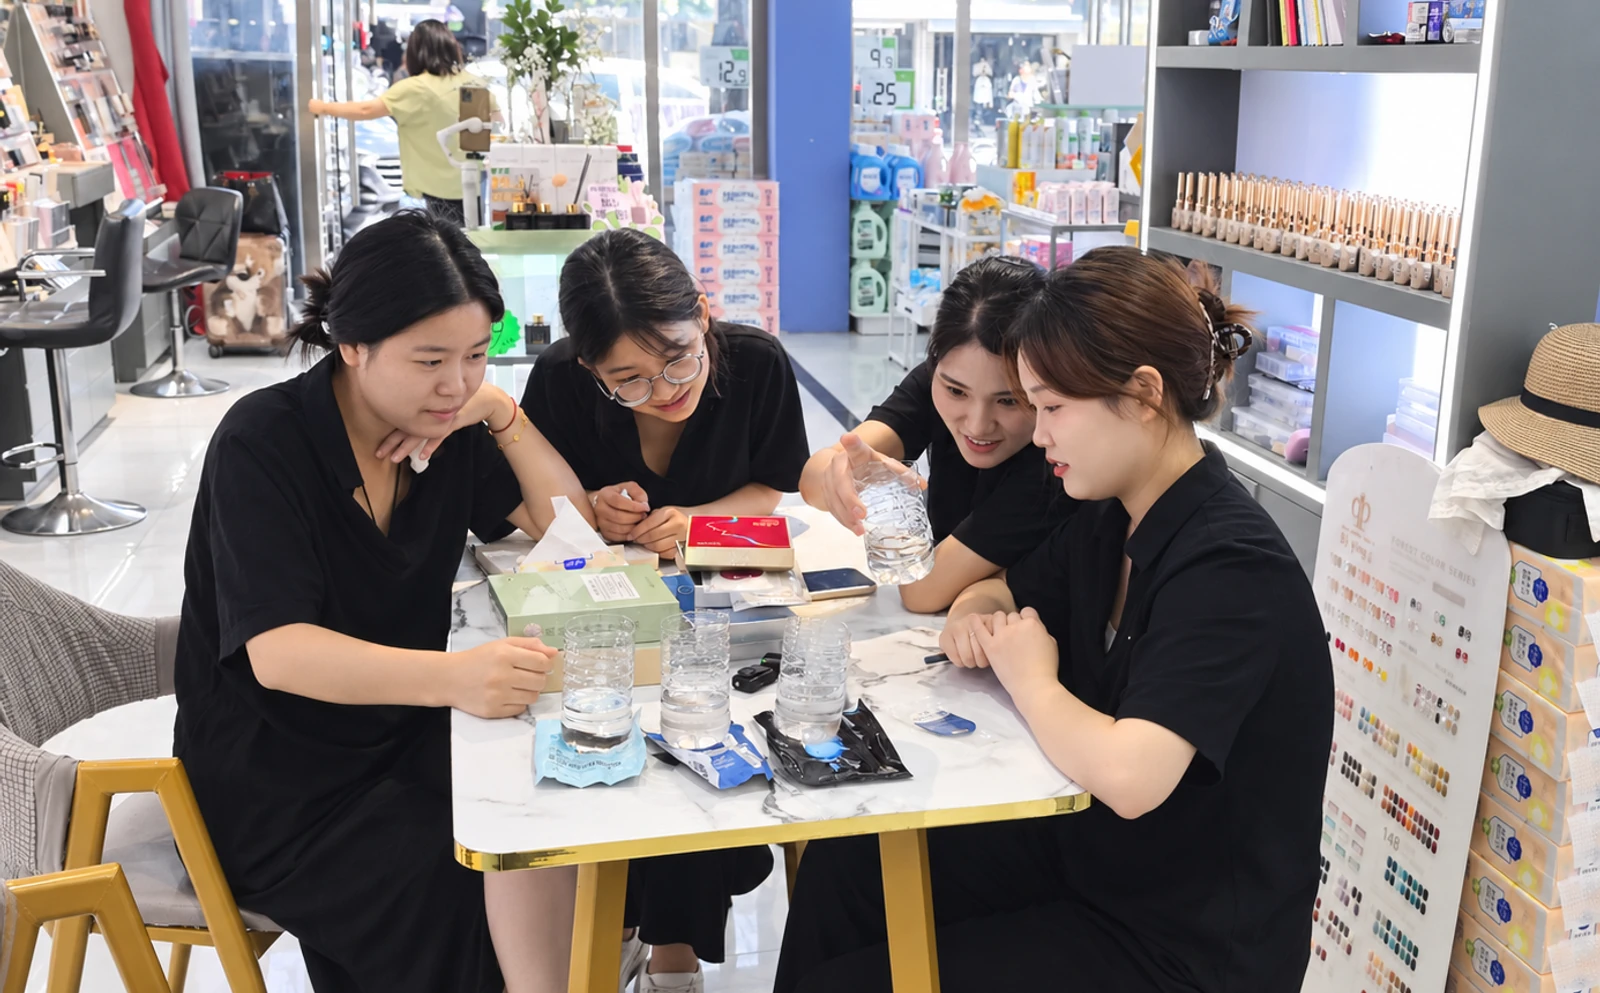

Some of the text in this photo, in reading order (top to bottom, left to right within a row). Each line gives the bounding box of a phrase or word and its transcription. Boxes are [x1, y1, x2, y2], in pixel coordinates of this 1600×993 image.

[1391, 535, 1418, 556] FOREST
[1420, 551, 1446, 571] COLOR
[1448, 564, 1476, 587] SERIES
[1383, 826, 1400, 851] 148
